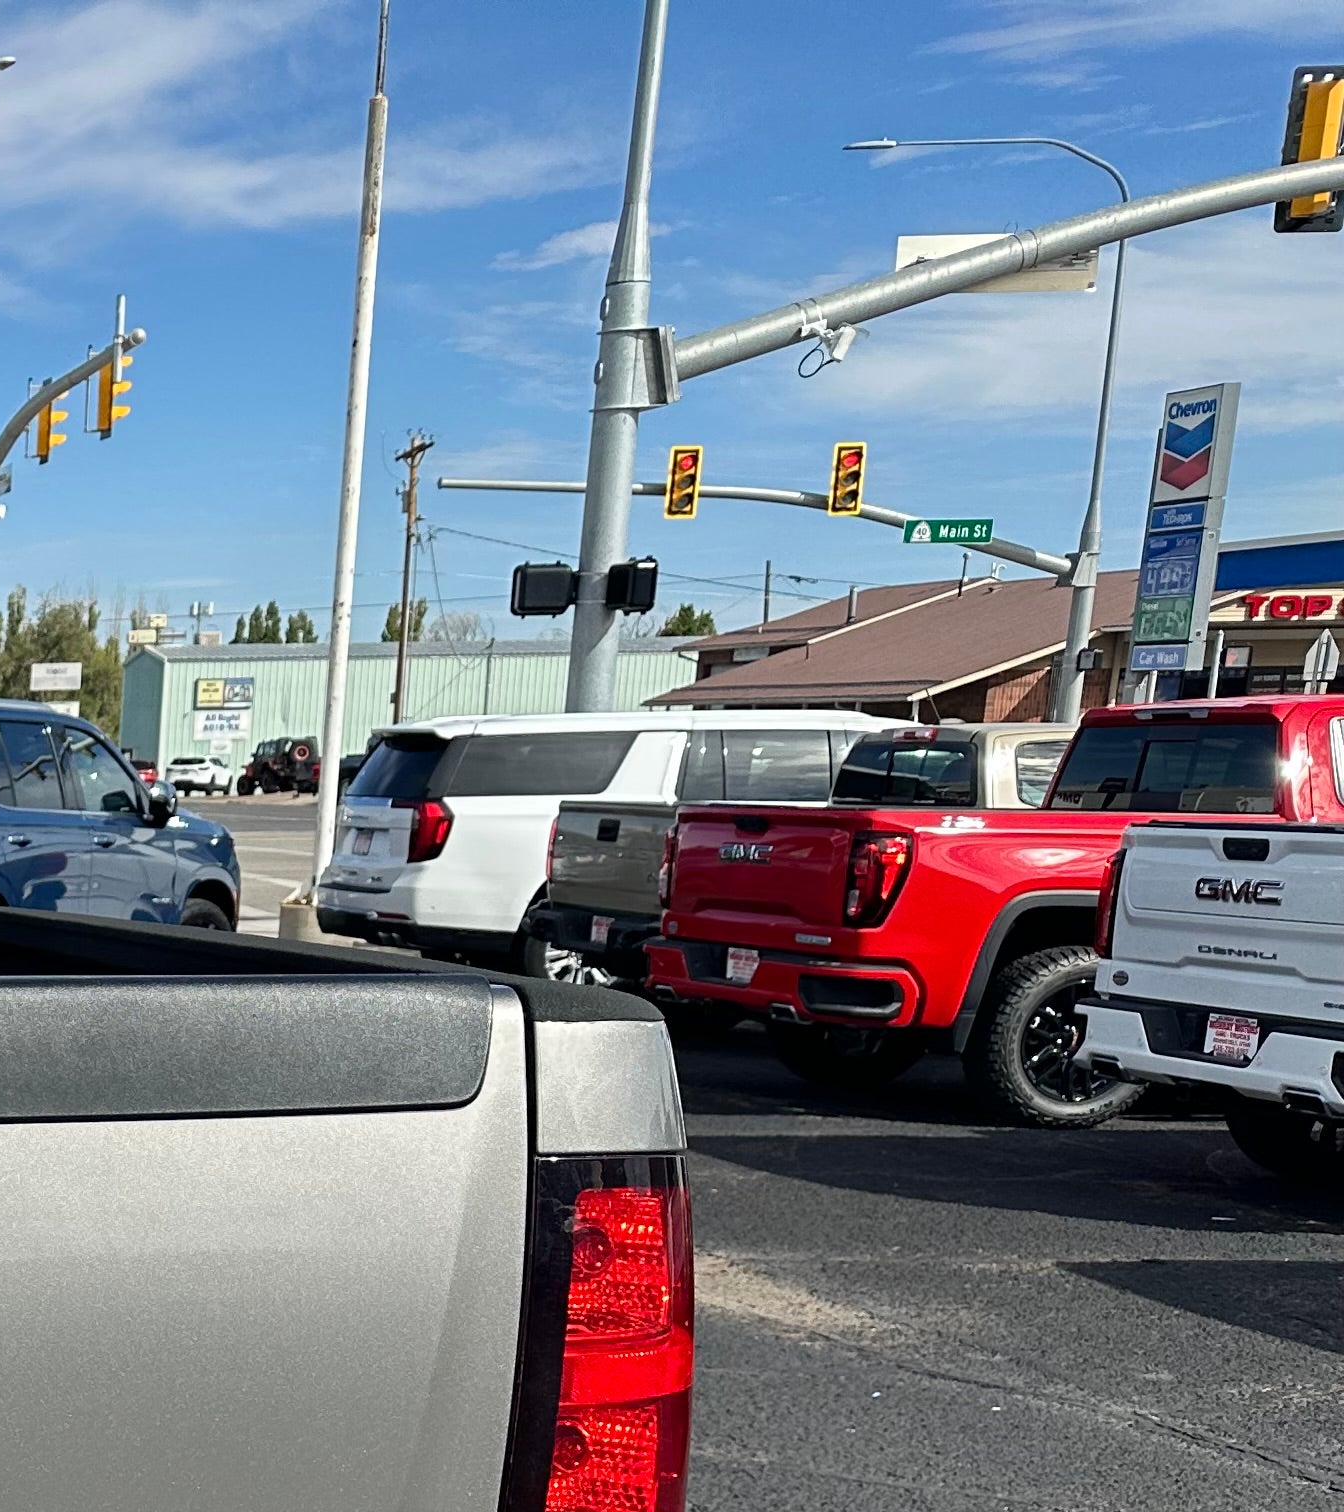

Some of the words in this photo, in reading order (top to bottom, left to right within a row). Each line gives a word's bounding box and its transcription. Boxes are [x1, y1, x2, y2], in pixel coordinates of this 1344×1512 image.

[1168, 399, 1217, 420] Chevron
[916, 527, 927, 536] 40
[939, 525, 969, 538] Main
[973, 524, 987, 538] St
[1243, 595, 1333, 619] TOP
[1139, 652, 1154, 665] Car
[1157, 651, 1179, 664] Wash
[718, 842, 774, 864] GMC
[1195, 877, 1285, 906] GMC
[1198, 944, 1278, 960] DENALI
